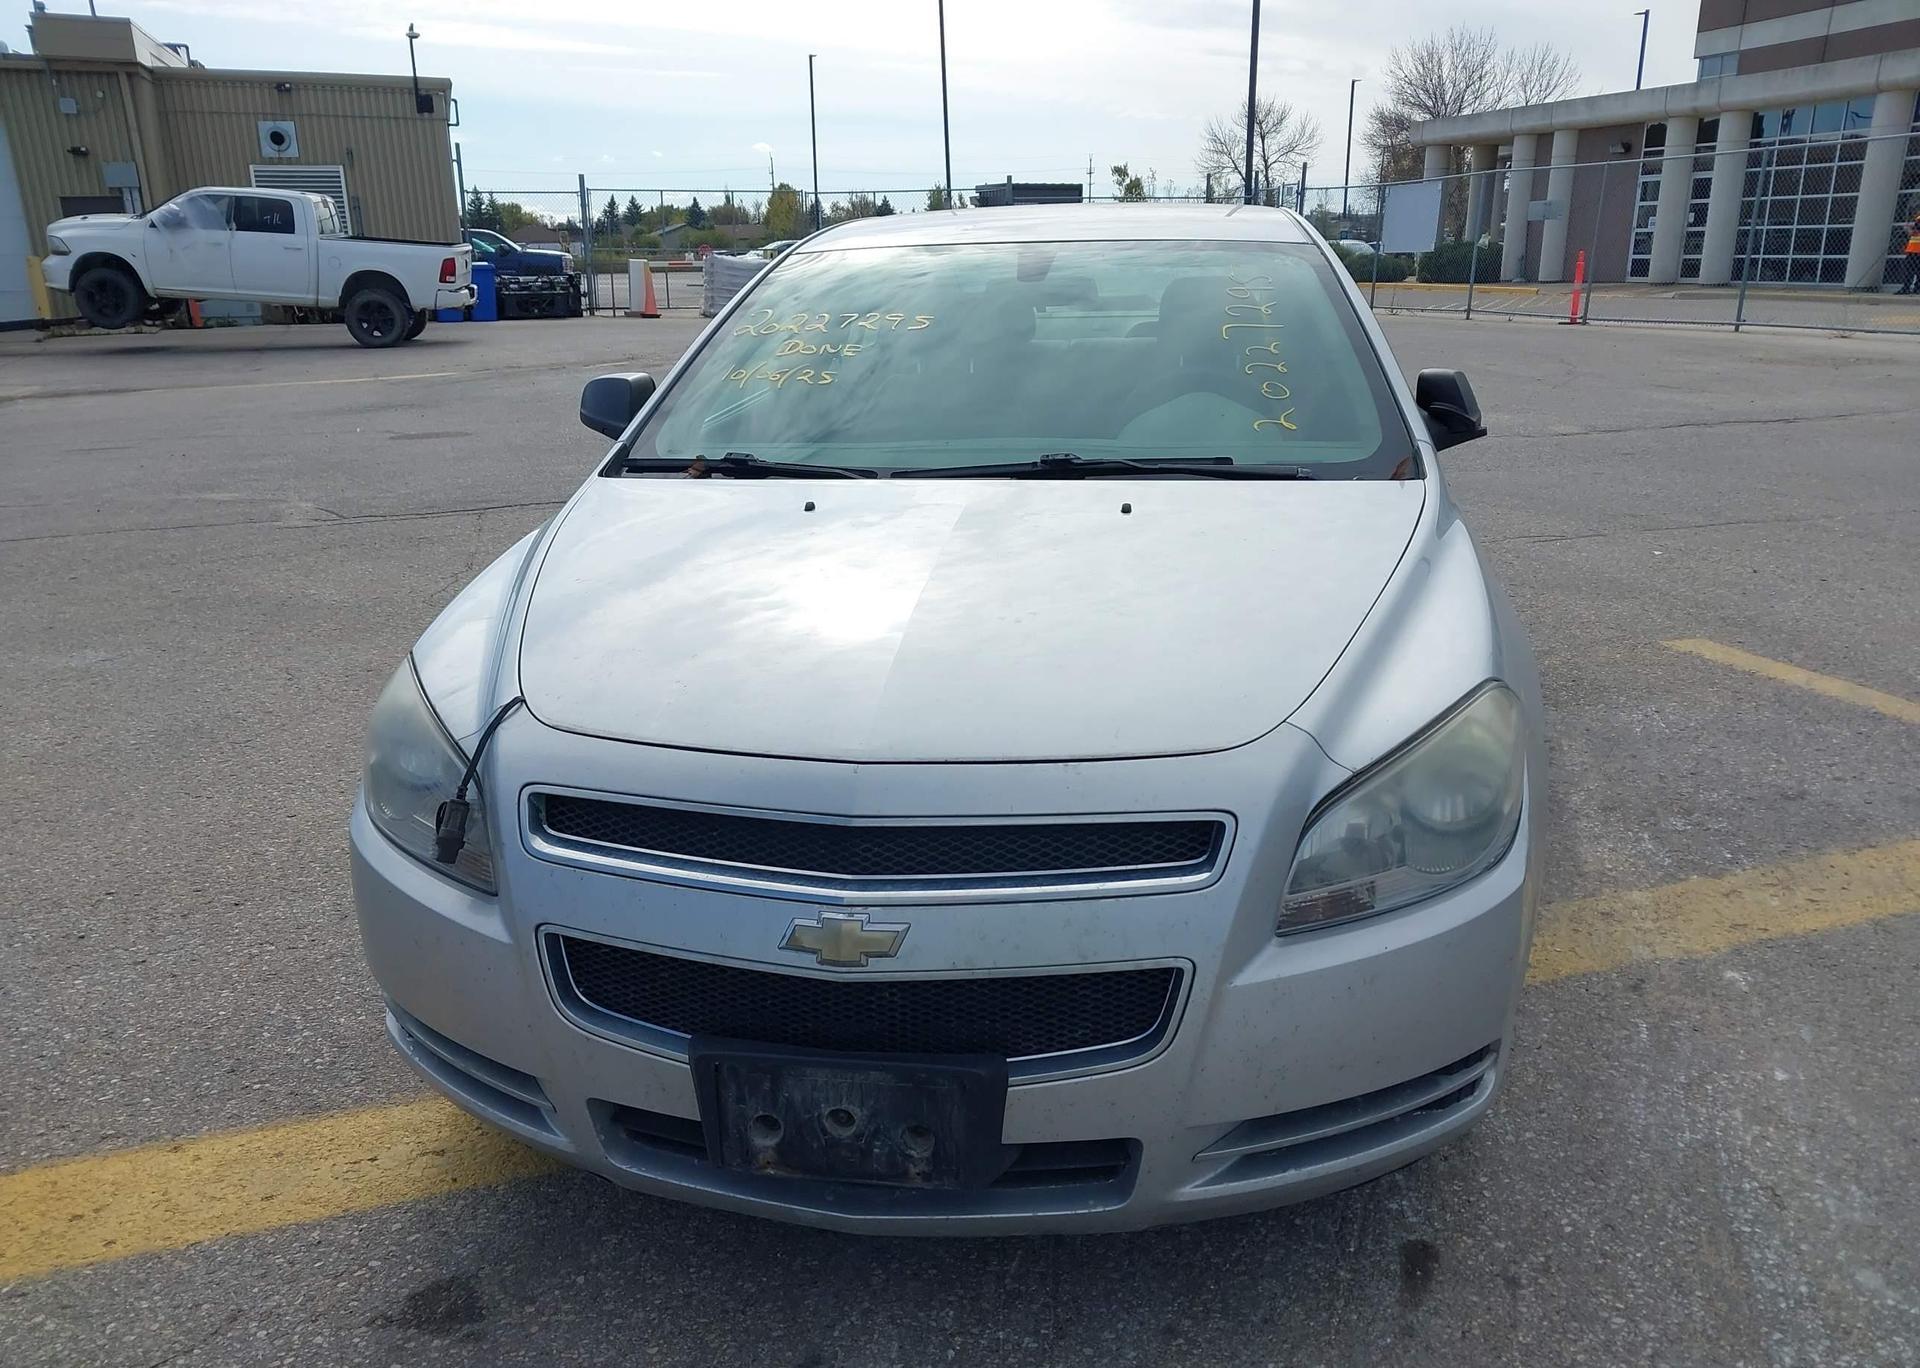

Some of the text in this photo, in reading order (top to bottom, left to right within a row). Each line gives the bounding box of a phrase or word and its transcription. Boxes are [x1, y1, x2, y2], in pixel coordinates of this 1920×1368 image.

[733, 308, 935, 337] 20227295
[776, 339, 875, 357] DONE
[1222, 264, 1297, 432] 20227295
